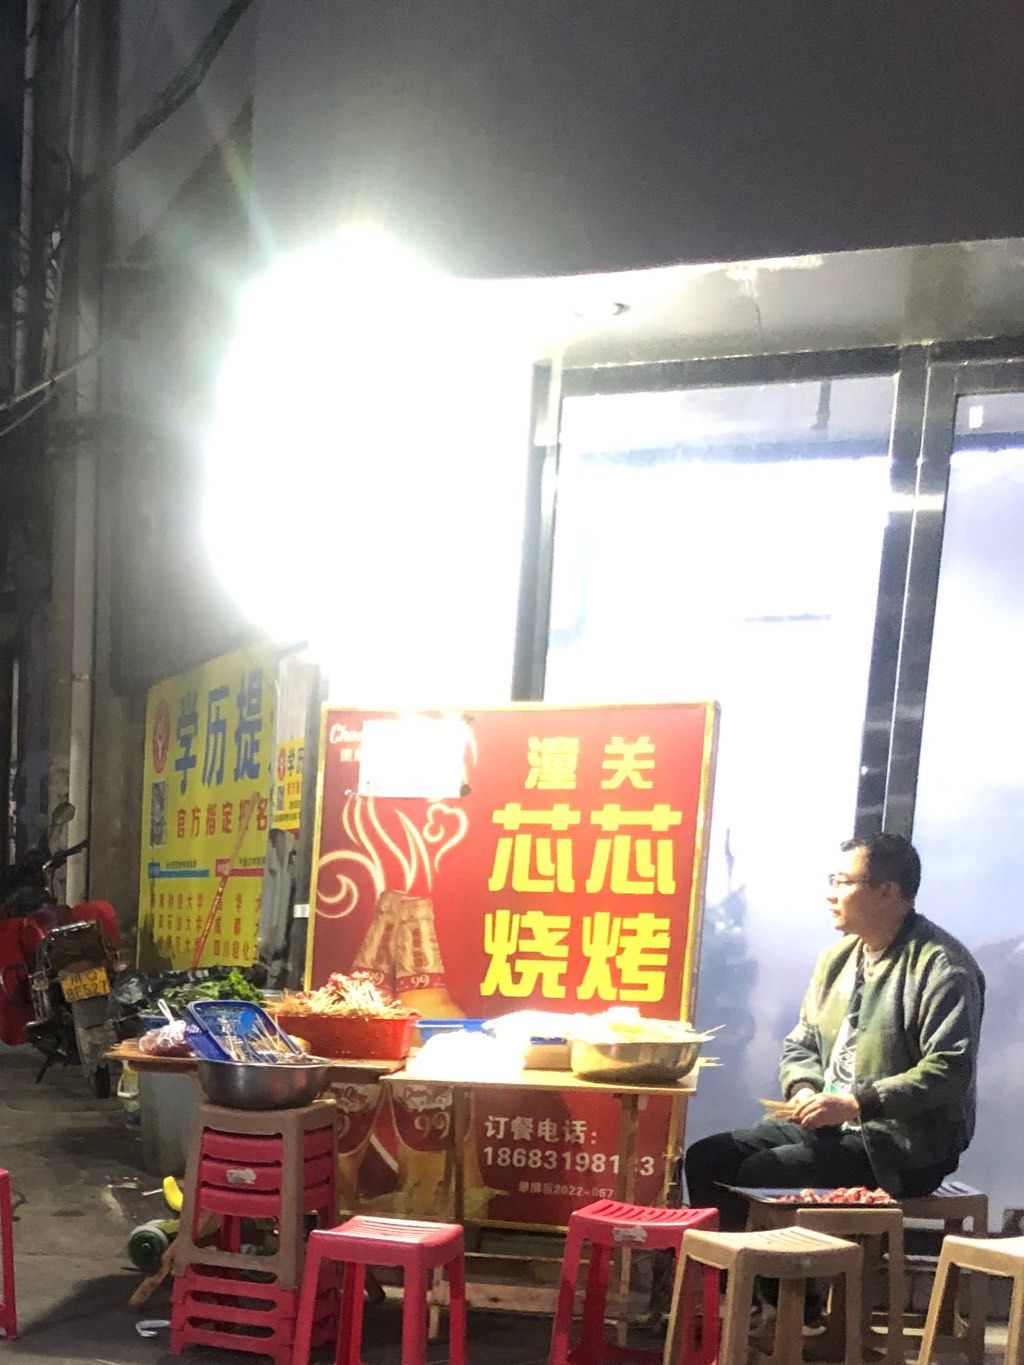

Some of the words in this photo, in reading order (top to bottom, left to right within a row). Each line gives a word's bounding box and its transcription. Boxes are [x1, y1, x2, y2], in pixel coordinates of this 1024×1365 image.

[176, 667, 271, 796] 学历提
[524, 736, 656, 790] 潼关
[487, 803, 683, 895] 芯芯
[480, 909, 672, 1003] 烧烤
[414, 1111, 451, 1140] 99
[483, 1146, 656, 1177] 1868319813
